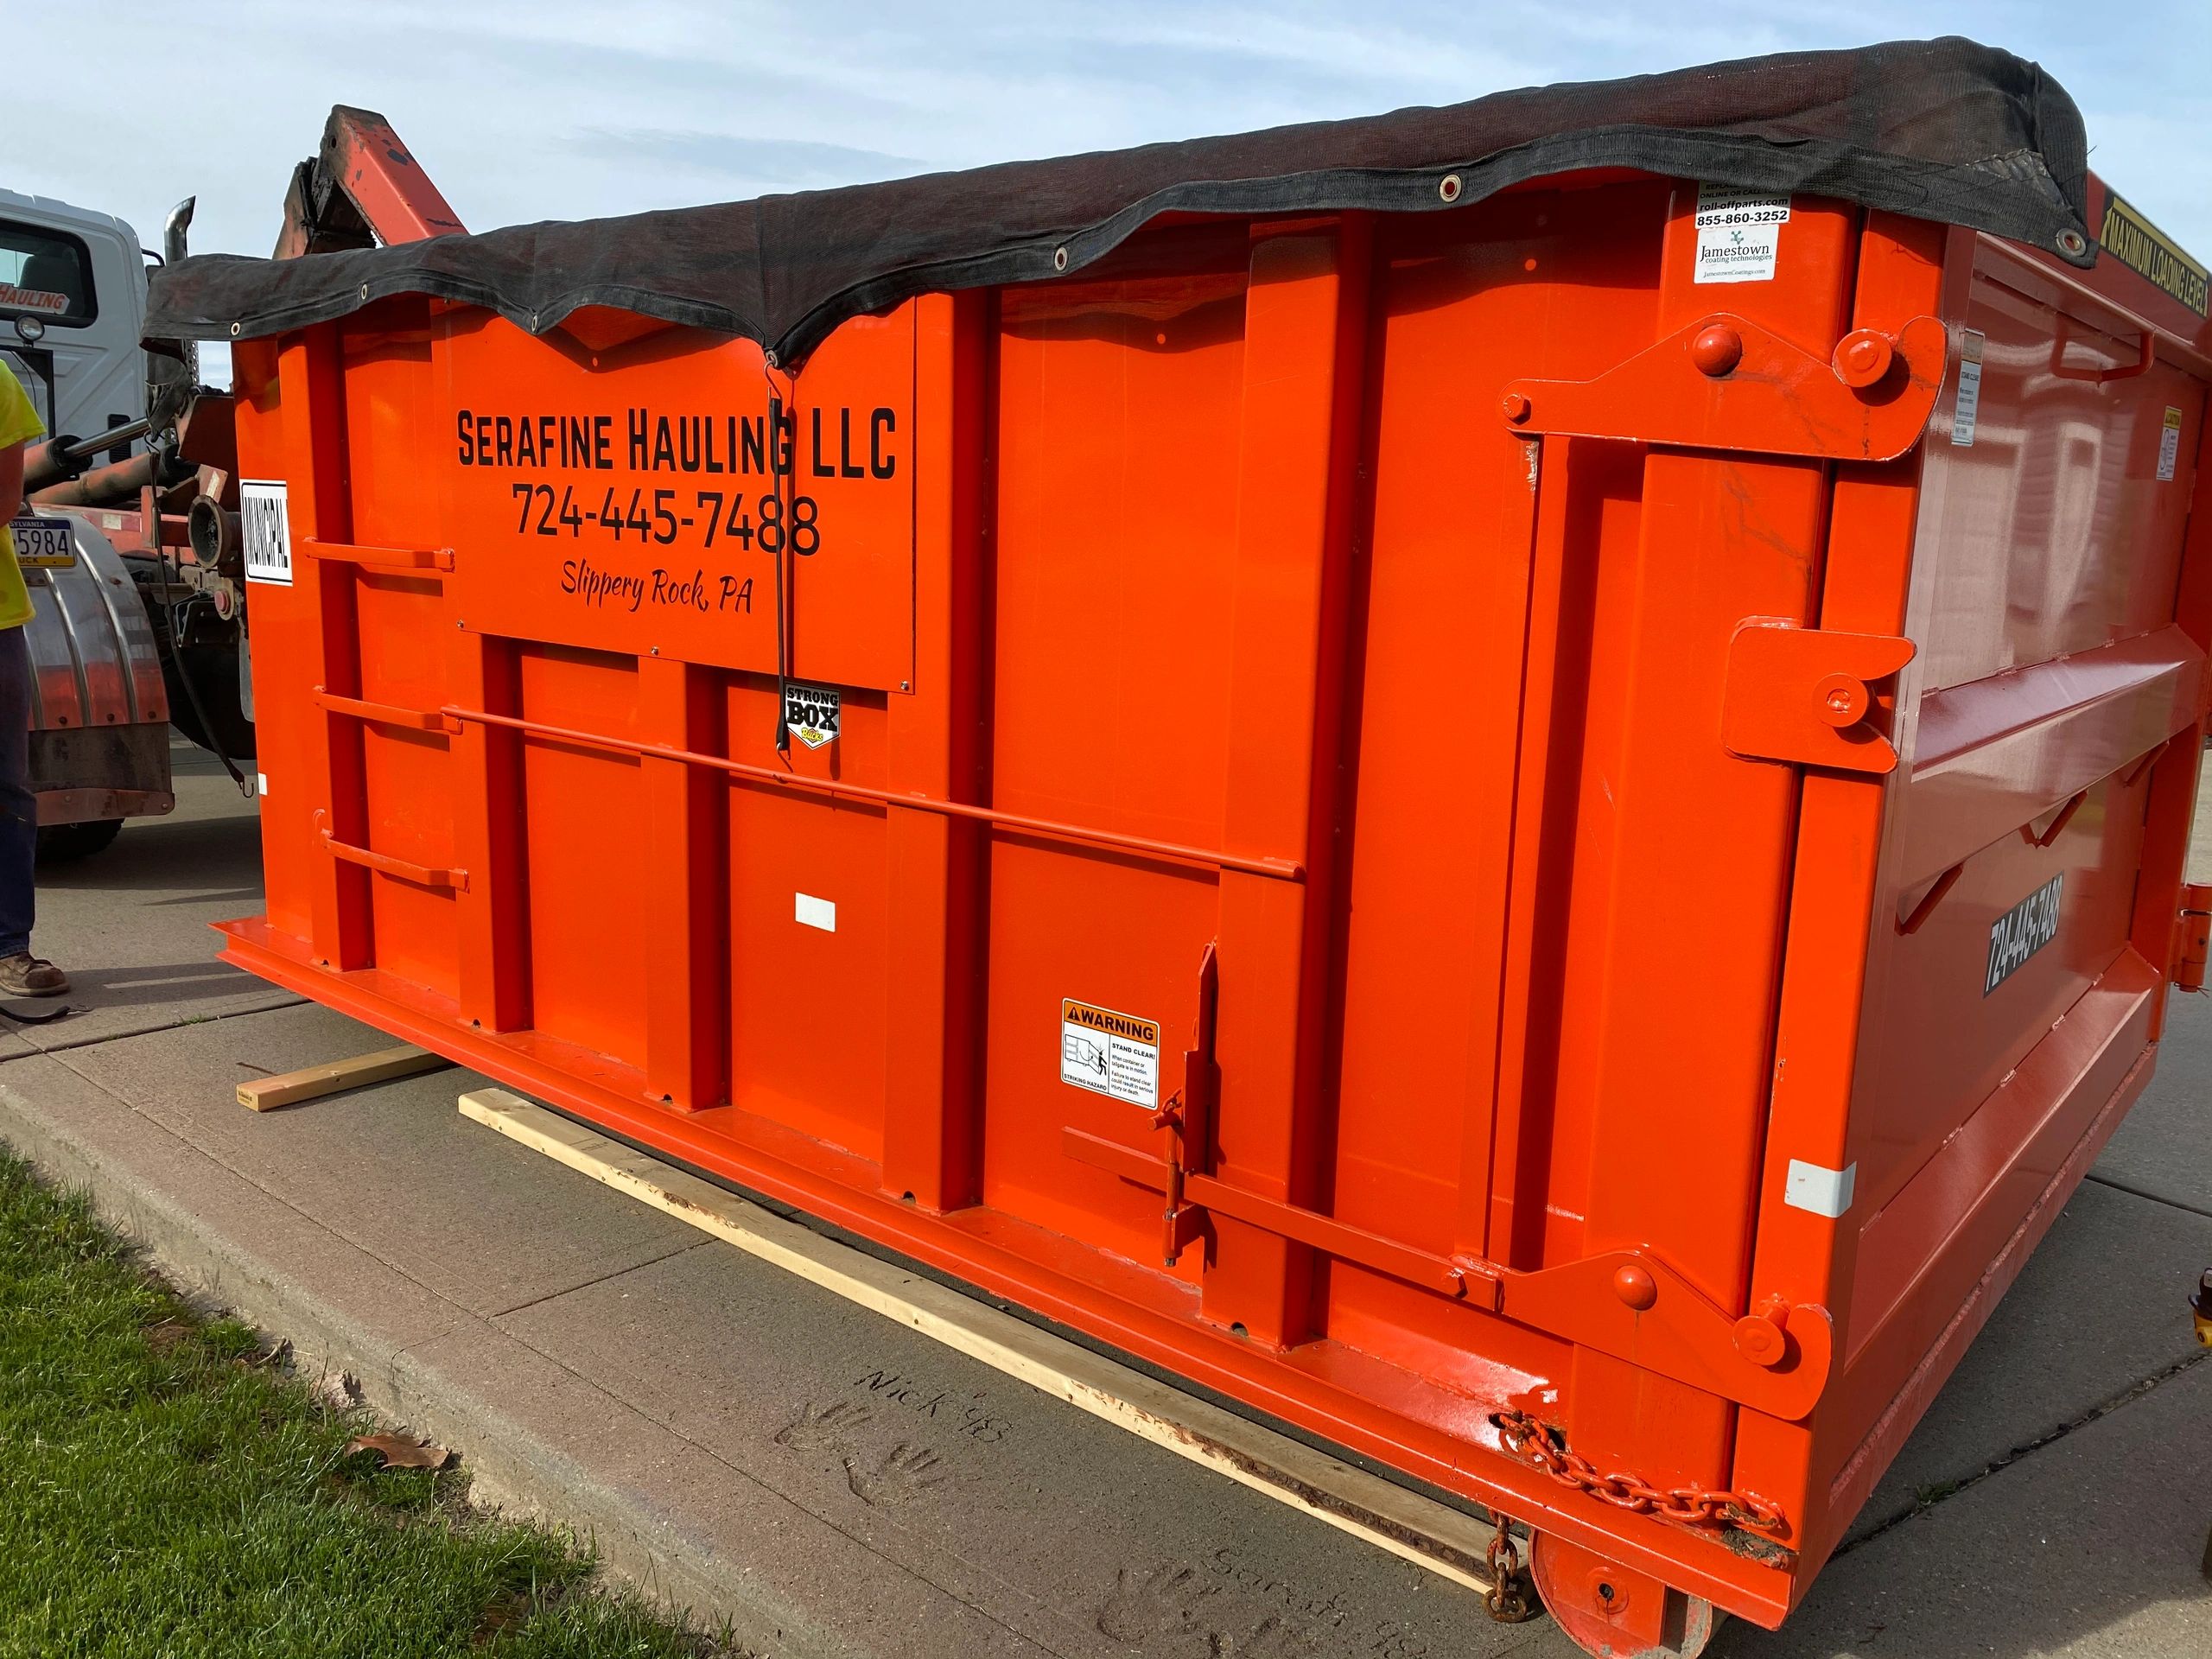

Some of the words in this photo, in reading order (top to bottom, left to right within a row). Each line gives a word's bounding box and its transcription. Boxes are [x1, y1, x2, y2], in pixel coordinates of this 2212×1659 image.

[1700, 198, 1789, 211] roll-offparts.com
[1697, 210, 1788, 226] 855-860-3252
[1700, 245, 1770, 262] Jamestown
[1731, 253, 1773, 262] technologies
[2108, 212, 2153, 276] MAXIMUM
[2151, 245, 2185, 299] LOADING
[2183, 270, 2203, 315] LEVEL
[0, 284, 65, 308] HAULING
[457, 409, 613, 471] SERAFINE
[627, 407, 793, 476] HAULING
[812, 407, 896, 480] LLC
[512, 483, 821, 556] 724-445-7488
[245, 496, 289, 569] MUNICIPAL
[561, 558, 644, 613] Slippery
[651, 568, 709, 613] Rock,
[719, 575, 754, 614] PA
[787, 687, 839, 707] STRONG
[787, 700, 839, 732] BOX
[801, 728, 823, 741] Bucks
[1081, 1008, 1154, 1041] WARNING
[1112, 1043, 1132, 1053] STAND
[1133, 1049, 1156, 1060] CLEAR!
[1064, 1073, 1086, 1084] STRIKING
[1087, 1080, 1107, 1090] HAZARD
